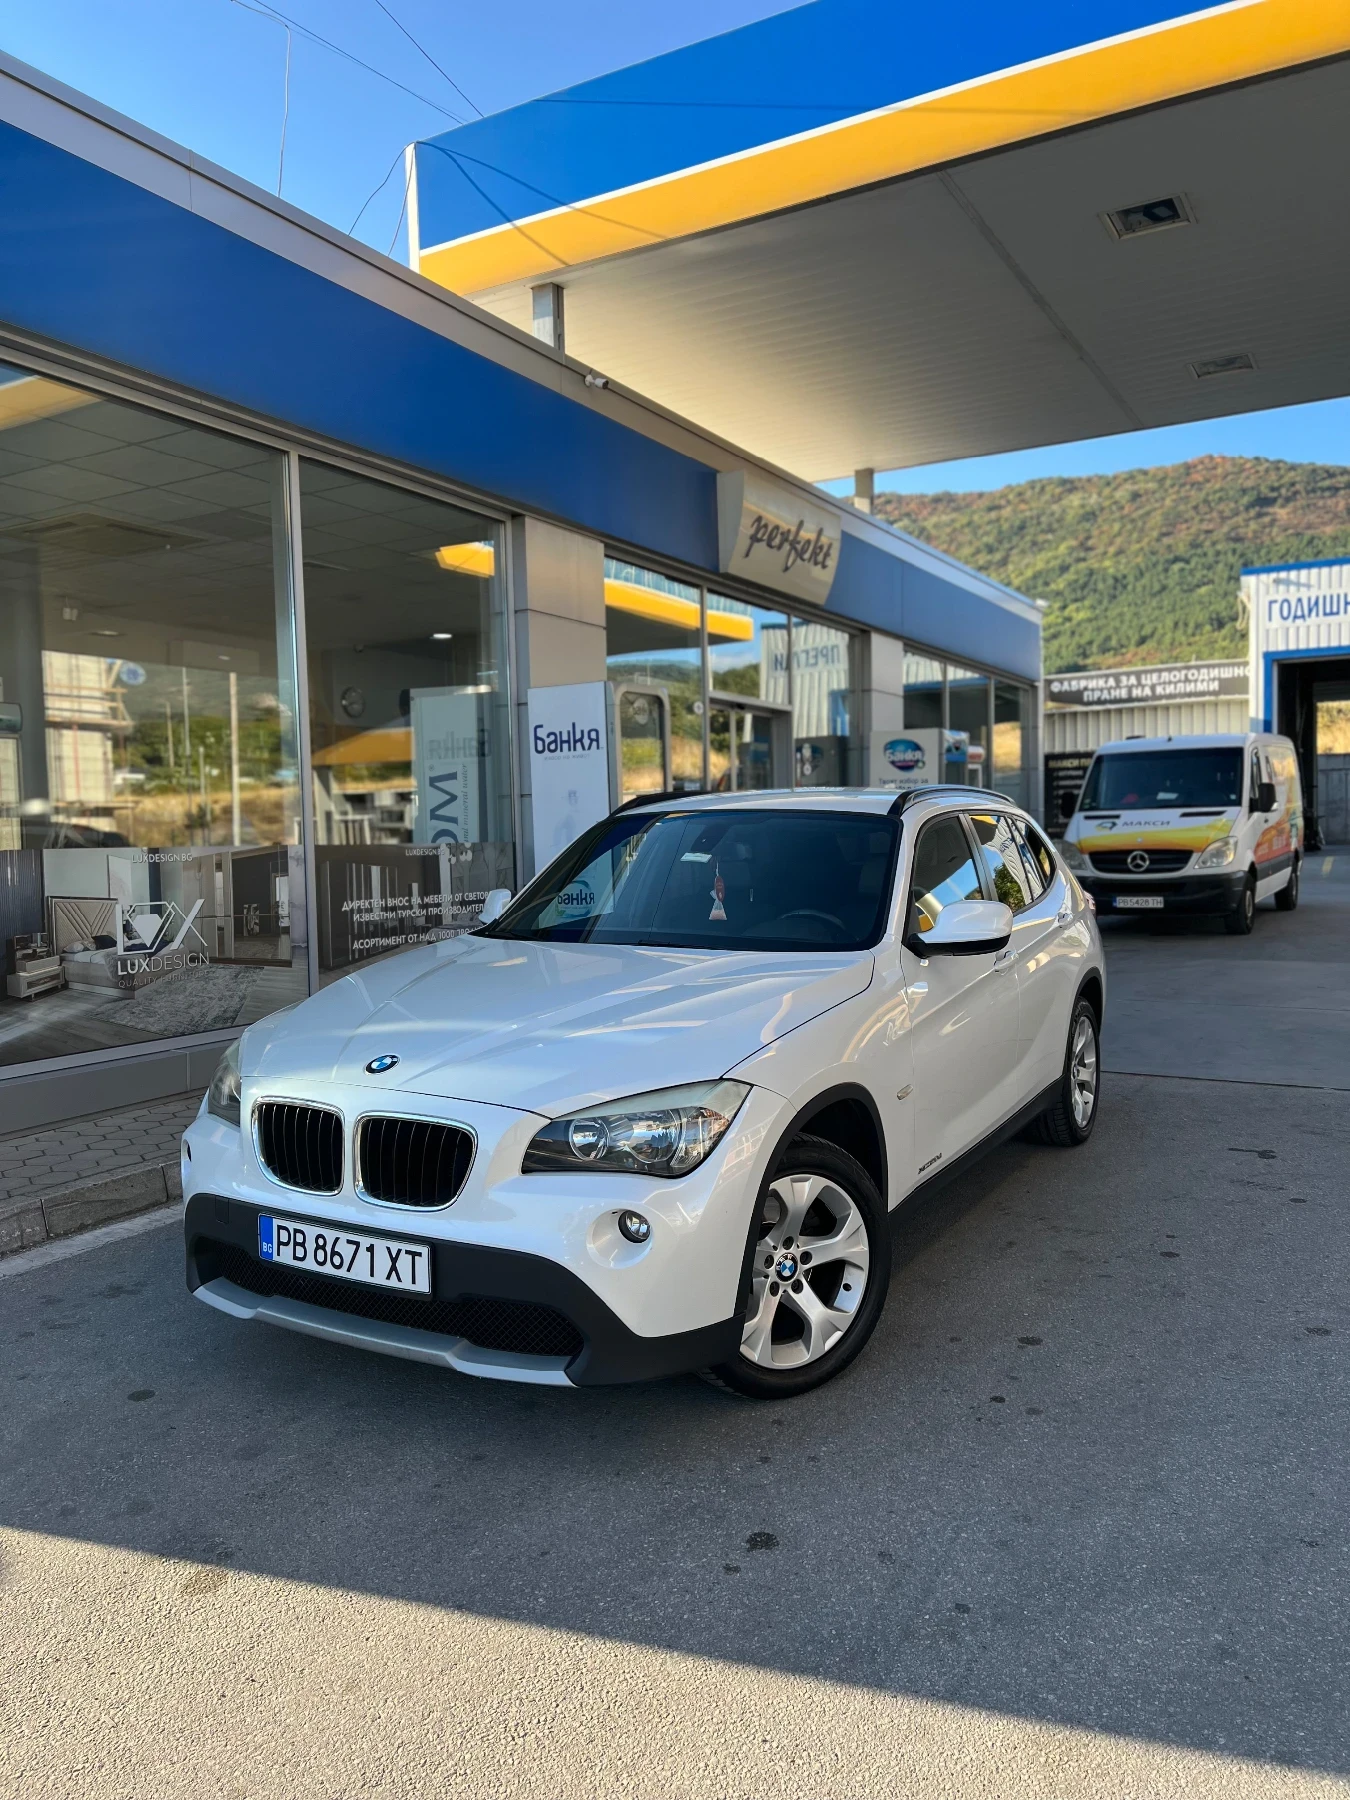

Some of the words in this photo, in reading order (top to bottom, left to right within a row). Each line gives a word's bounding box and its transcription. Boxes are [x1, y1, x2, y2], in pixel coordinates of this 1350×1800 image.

[743, 515, 833, 573] perfekt
[1050, 676, 1116, 693] ФАБРИКА
[1119, 675, 1138, 687] ЗА
[1083, 687, 1129, 702] ПРАНЕ
[1132, 686, 1152, 698] НА
[1155, 680, 1220, 695] КИЛИМИ
[461, 763, 469, 789] water
[341, 898, 386, 912] ДИРЕКТЕН
[387, 896, 410, 907] ВНОС
[411, 896, 423, 905] НА
[423, 893, 453, 904] МЕБЕЛИ
[454, 892, 463, 902] ОТ
[1118, 898, 1129, 907] PB
[1129, 898, 1150, 907] 5428
[1151, 898, 1163, 907] TH
[353, 911, 396, 922] ИЗВЕСТНИ
[397, 908, 427, 919] ТУРСКИ
[352, 934, 406, 950] АСОРТИМЕНТ
[407, 934, 417, 943] ОТ
[419, 932, 437, 942] НАД
[438, 930, 455, 940] 1000
[117, 951, 210, 976] LUXDESIGN
[118, 976, 158, 988] QUALITY
[262, 1241, 273, 1254] BG
[276, 1224, 308, 1262] PB
[313, 1233, 375, 1278] 8671
[385, 1246, 423, 1285] XT
